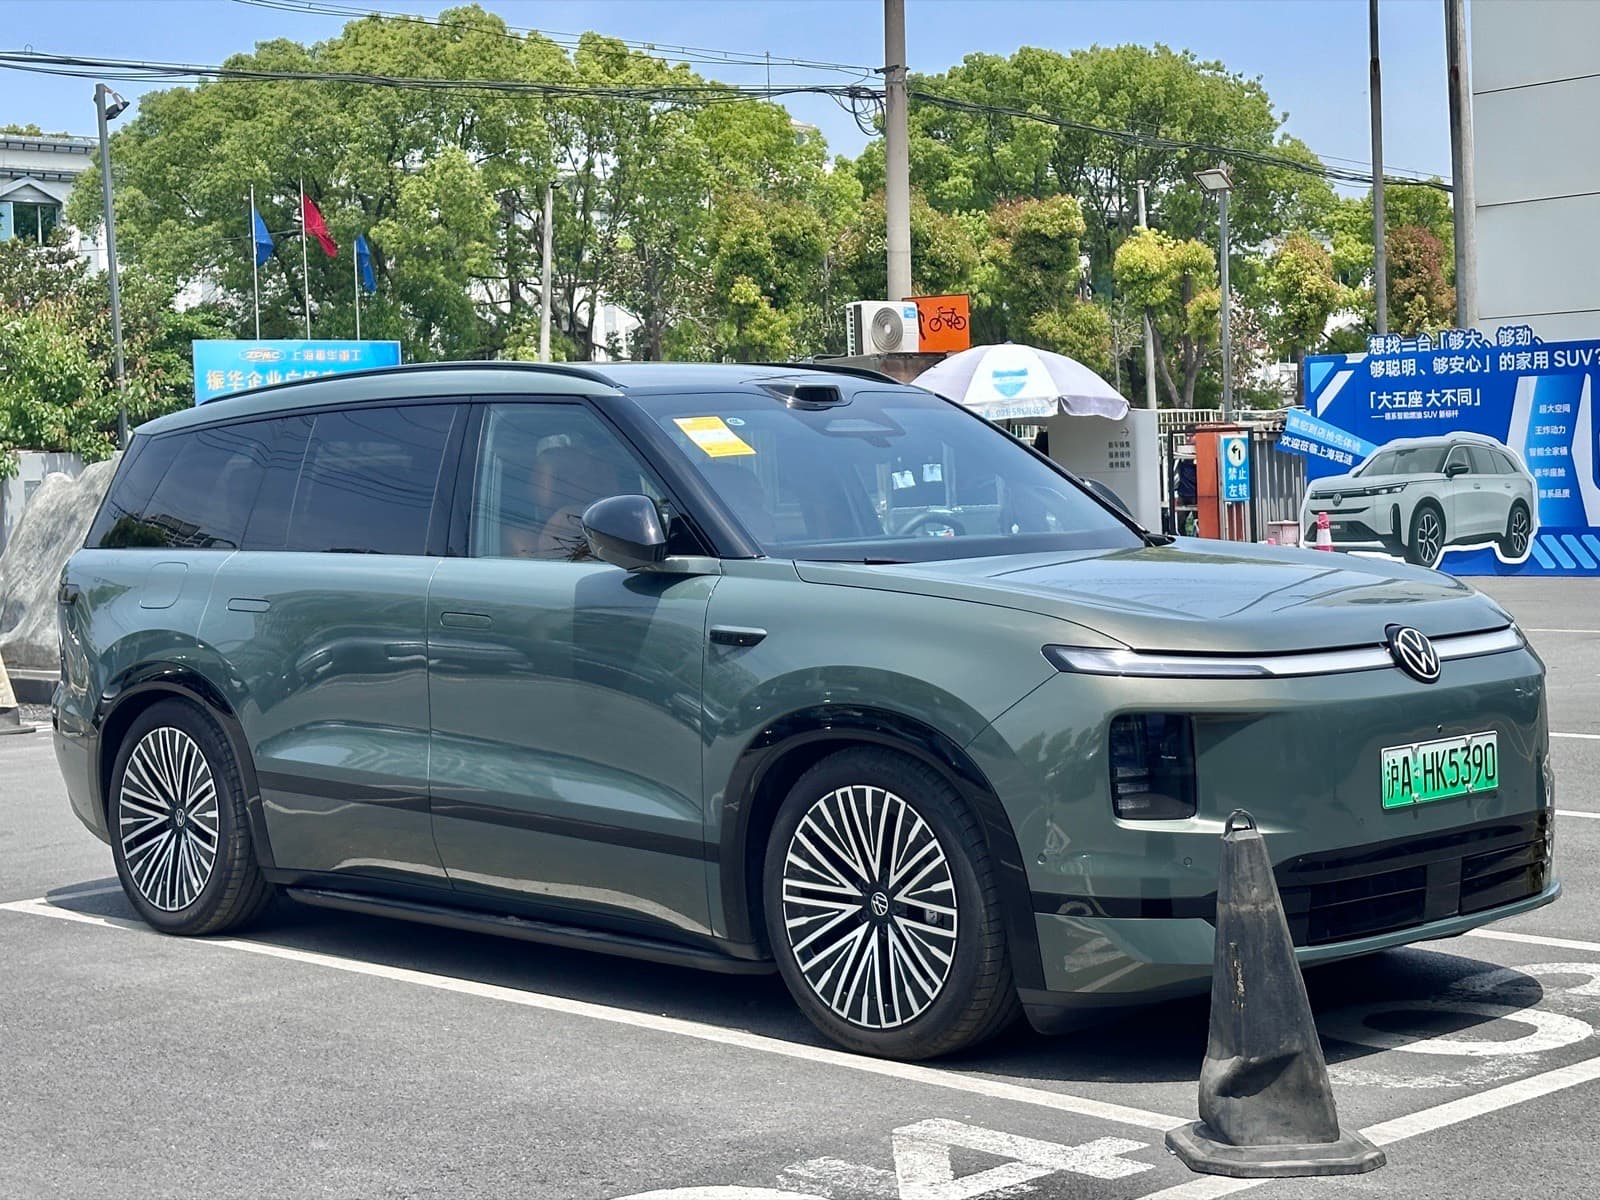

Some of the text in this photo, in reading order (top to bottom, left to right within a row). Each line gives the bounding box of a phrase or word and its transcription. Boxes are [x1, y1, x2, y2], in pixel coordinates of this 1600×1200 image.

[1423, 410, 1438, 419] SUV
[1228, 467, 1248, 481] 禁止
[1228, 483, 1248, 497] 左转
